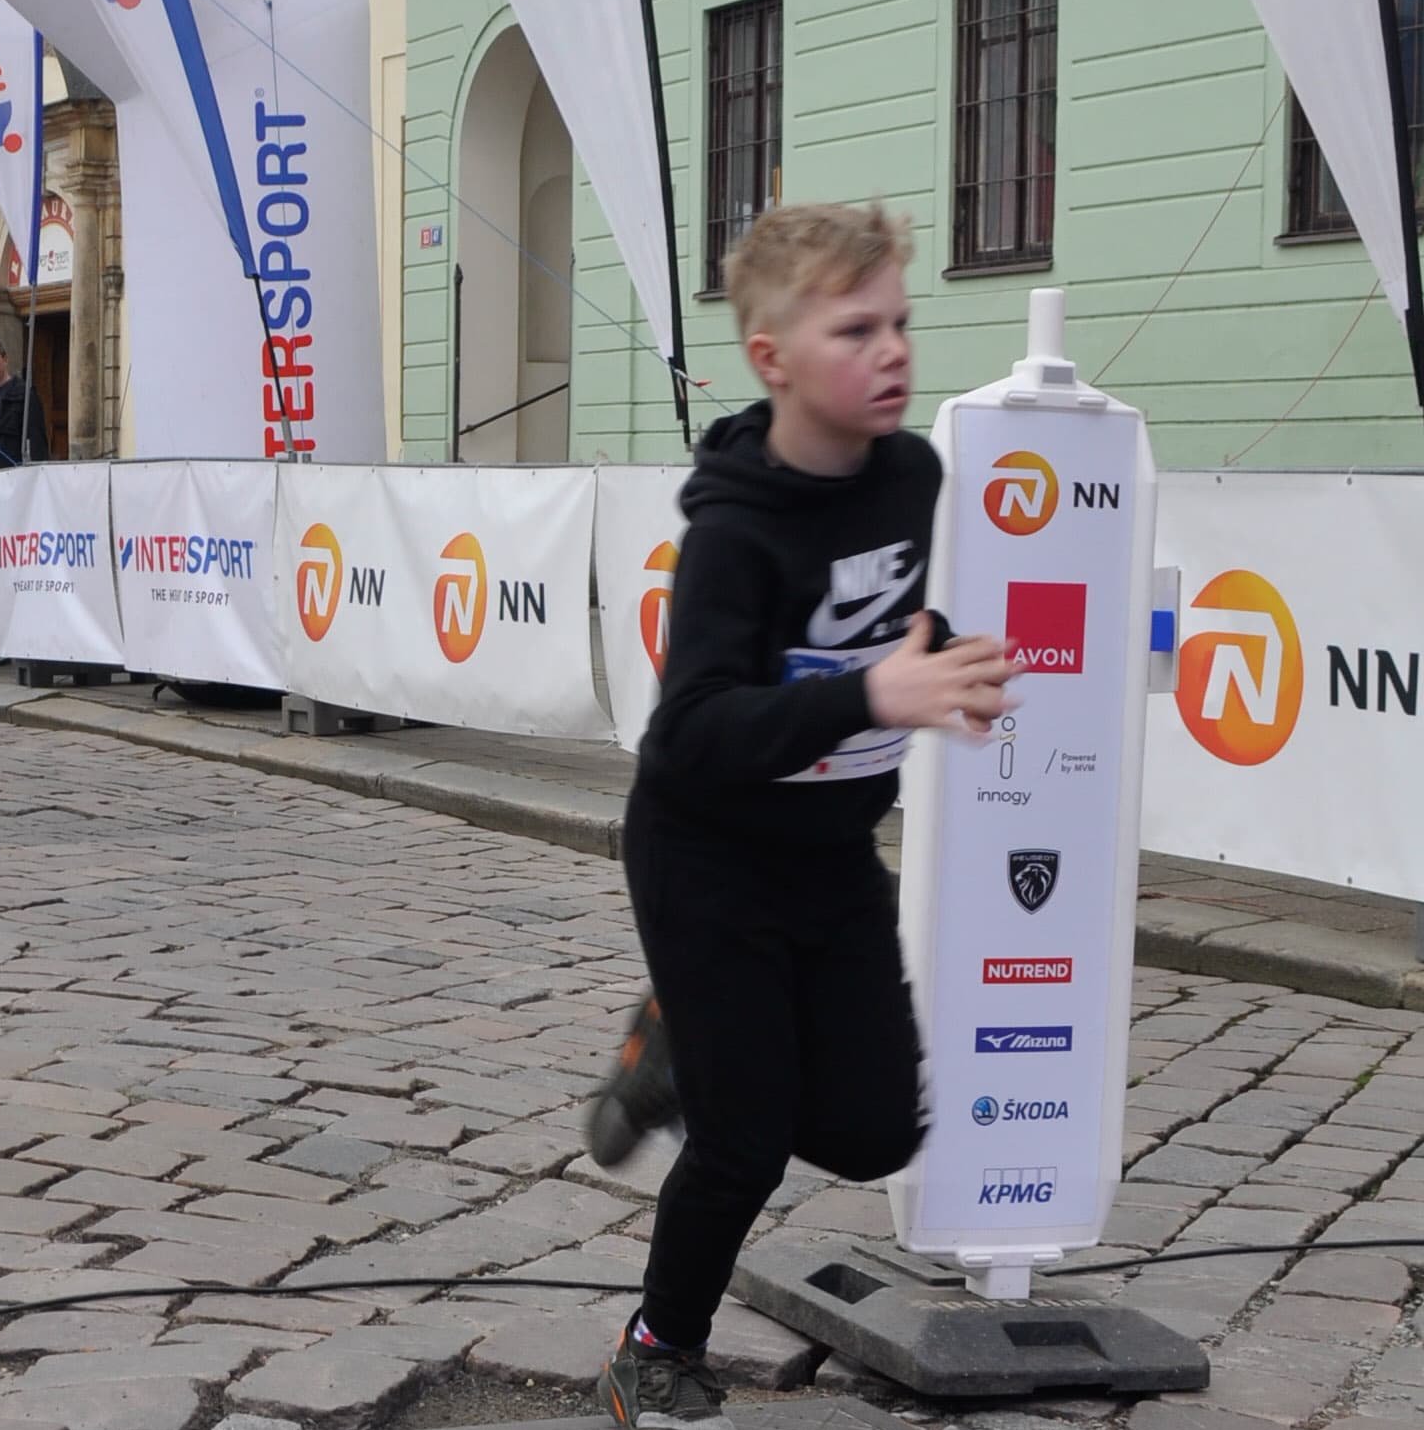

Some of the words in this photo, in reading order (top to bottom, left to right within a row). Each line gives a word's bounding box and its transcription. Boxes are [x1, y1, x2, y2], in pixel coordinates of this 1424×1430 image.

[255, 101, 316, 459] TERSPORT
[1072, 482, 1120, 509] NN
[135, 535, 254, 580] INTERSPORT
[349, 566, 385, 606] NN
[195, 591, 230, 606] SPORT
[498, 579, 546, 625] NN
[1012, 647, 1075, 666] AVON
[1327, 644, 1420, 717] NN
[1061, 752, 1096, 762] Powered
[1061, 763, 1072, 773] by
[977, 787, 1031, 805] innogy
[988, 962, 1069, 979] NUTREND
[1002, 1098, 1069, 1121] ŠKODA
[978, 1181, 1054, 1205] KPMG
